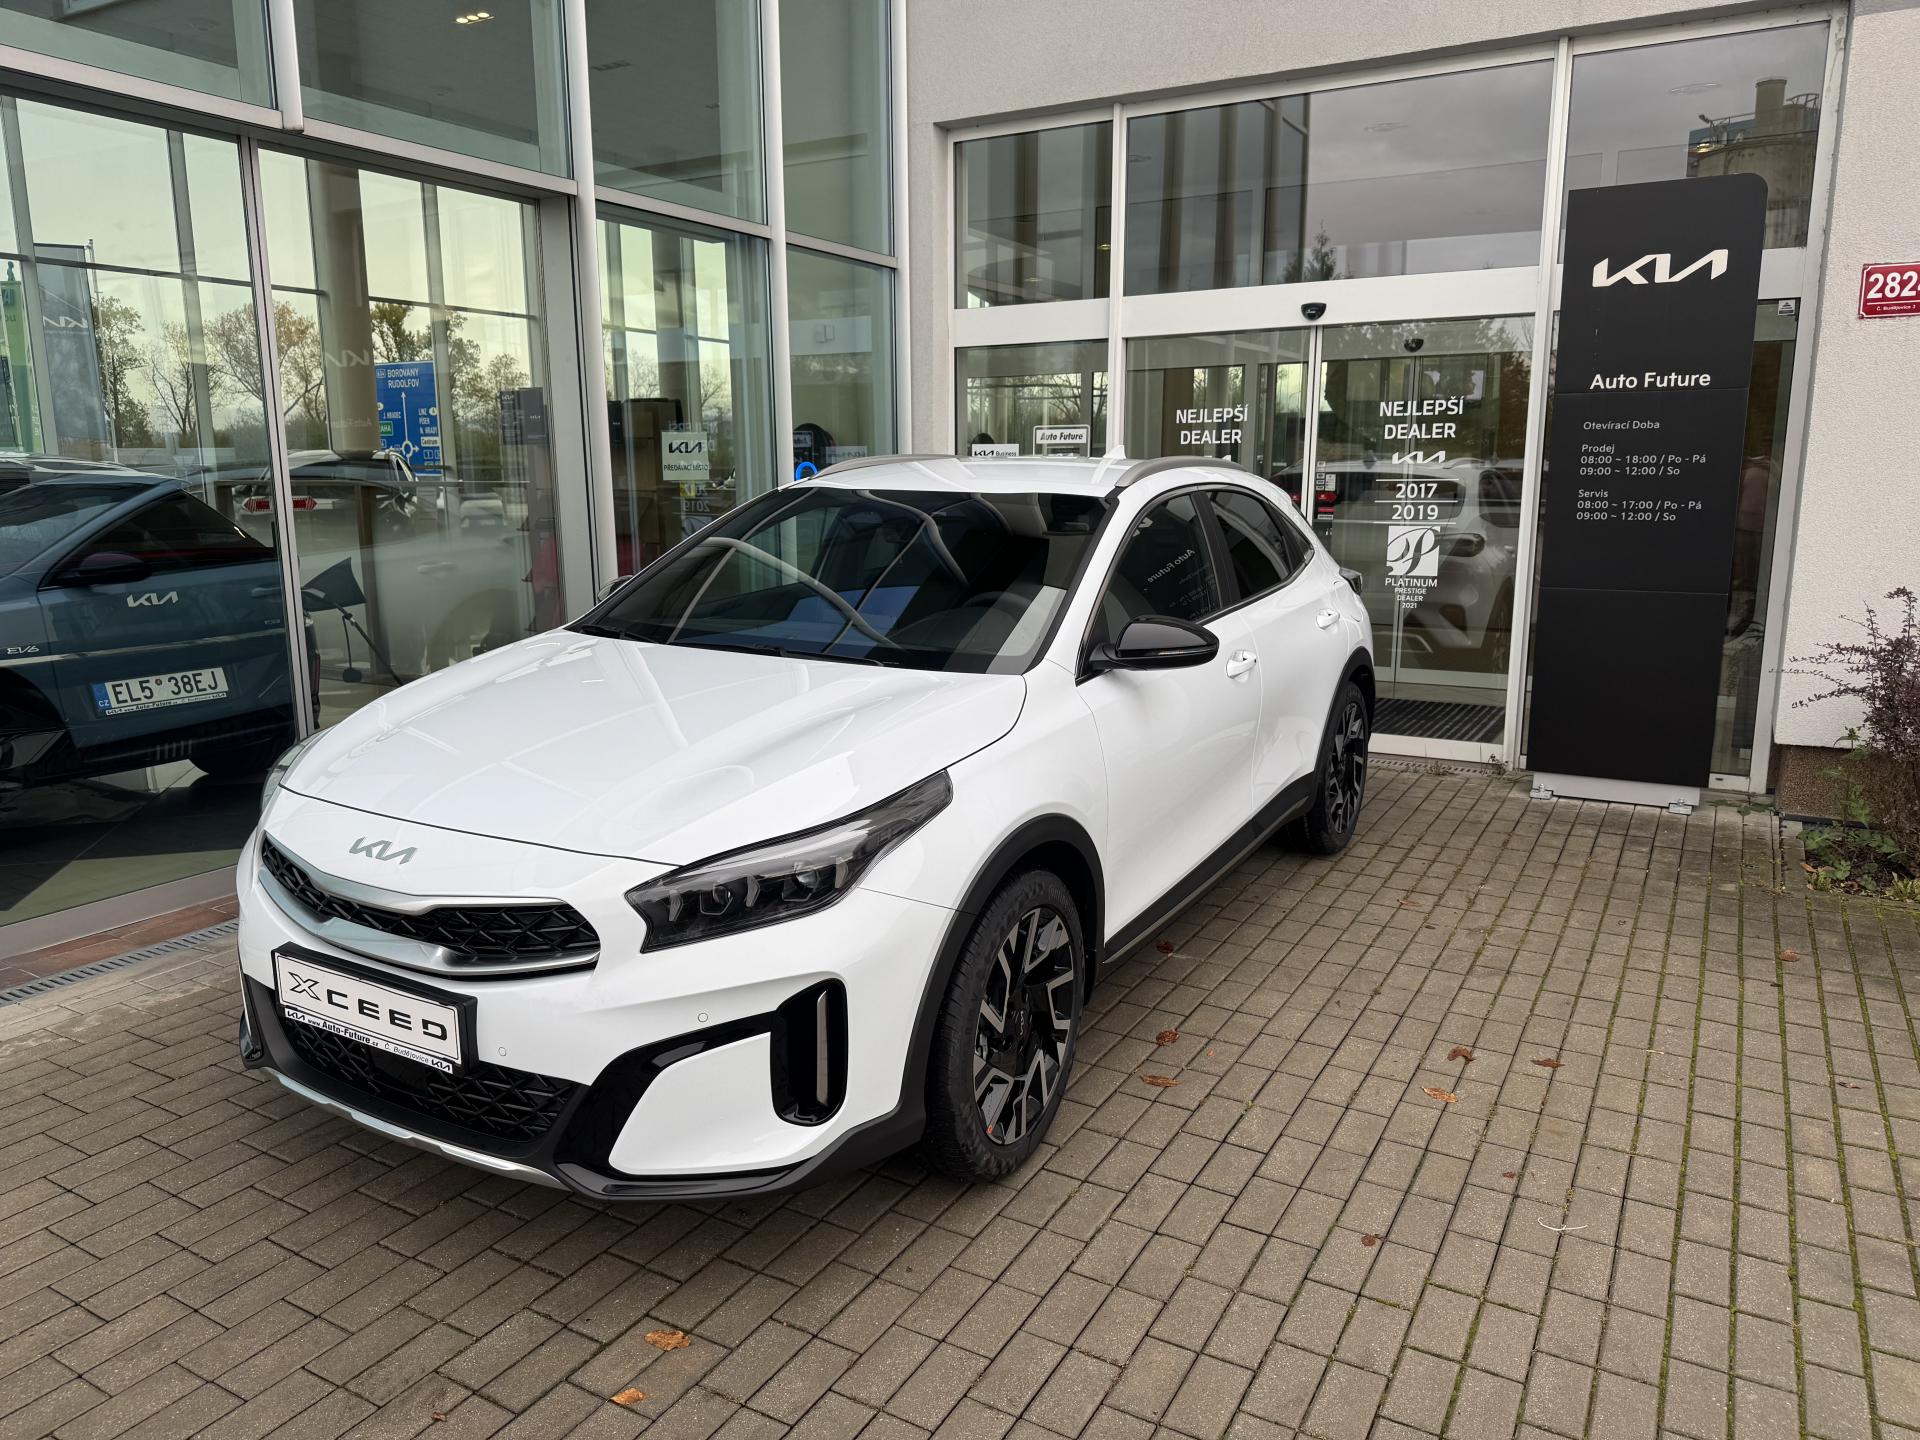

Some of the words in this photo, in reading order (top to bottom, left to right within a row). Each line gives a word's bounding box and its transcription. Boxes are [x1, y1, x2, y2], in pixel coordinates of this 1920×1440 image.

[1592, 249, 1728, 287] KIA
[1866, 270, 1920, 299] 282
[387, 368, 419, 378] BOROVANY
[388, 378, 420, 388] RUDOLFOV
[1590, 374, 1638, 389] Auto
[1644, 372, 1711, 388] Future
[1379, 396, 1464, 416] NEJLEPŠÍ
[1176, 404, 1248, 423] NEJLEPŠÍ
[1384, 423, 1456, 439] DEALER
[1583, 420, 1631, 430] Otevírací
[1632, 420, 1660, 429] Doba
[1040, 432, 1057, 441] Auto
[1059, 432, 1083, 440] Future
[1180, 429, 1242, 445] DEALER
[669, 442, 702, 453] KIA
[1581, 444, 1615, 454] Prodej
[1392, 450, 1446, 464] KIA
[1580, 455, 1612, 464] 08:00
[1625, 455, 1657, 464] 18:00
[1667, 454, 1681, 463] Po
[1692, 454, 1706, 463] Pá
[1580, 467, 1611, 475] 09:00
[1625, 466, 1656, 475] 12:00
[1667, 466, 1680, 475] So
[1395, 483, 1437, 499] 2017
[1578, 489, 1609, 498] Servis
[1577, 500, 1609, 509] 08:00
[1622, 500, 1653, 509] 17:00
[1664, 500, 1678, 509] Po
[1688, 500, 1702, 510] Pá
[1391, 505, 1439, 520] 2019
[1576, 512, 1608, 520] 09:00
[1620, 512, 1652, 520] 12:00
[1663, 512, 1676, 520] So
[1385, 578, 1438, 588] PLATINUM
[126, 591, 179, 607] KIA
[7, 646, 40, 654] EV6
[111, 679, 154, 705] EL5
[167, 670, 218, 695] 38EJ
[99, 700, 109, 708] CZ
[349, 836, 418, 864] KIA
[288, 971, 447, 1042] XCEED
[287, 1010, 305, 1021] KIA
[431, 1059, 451, 1071] KIA
